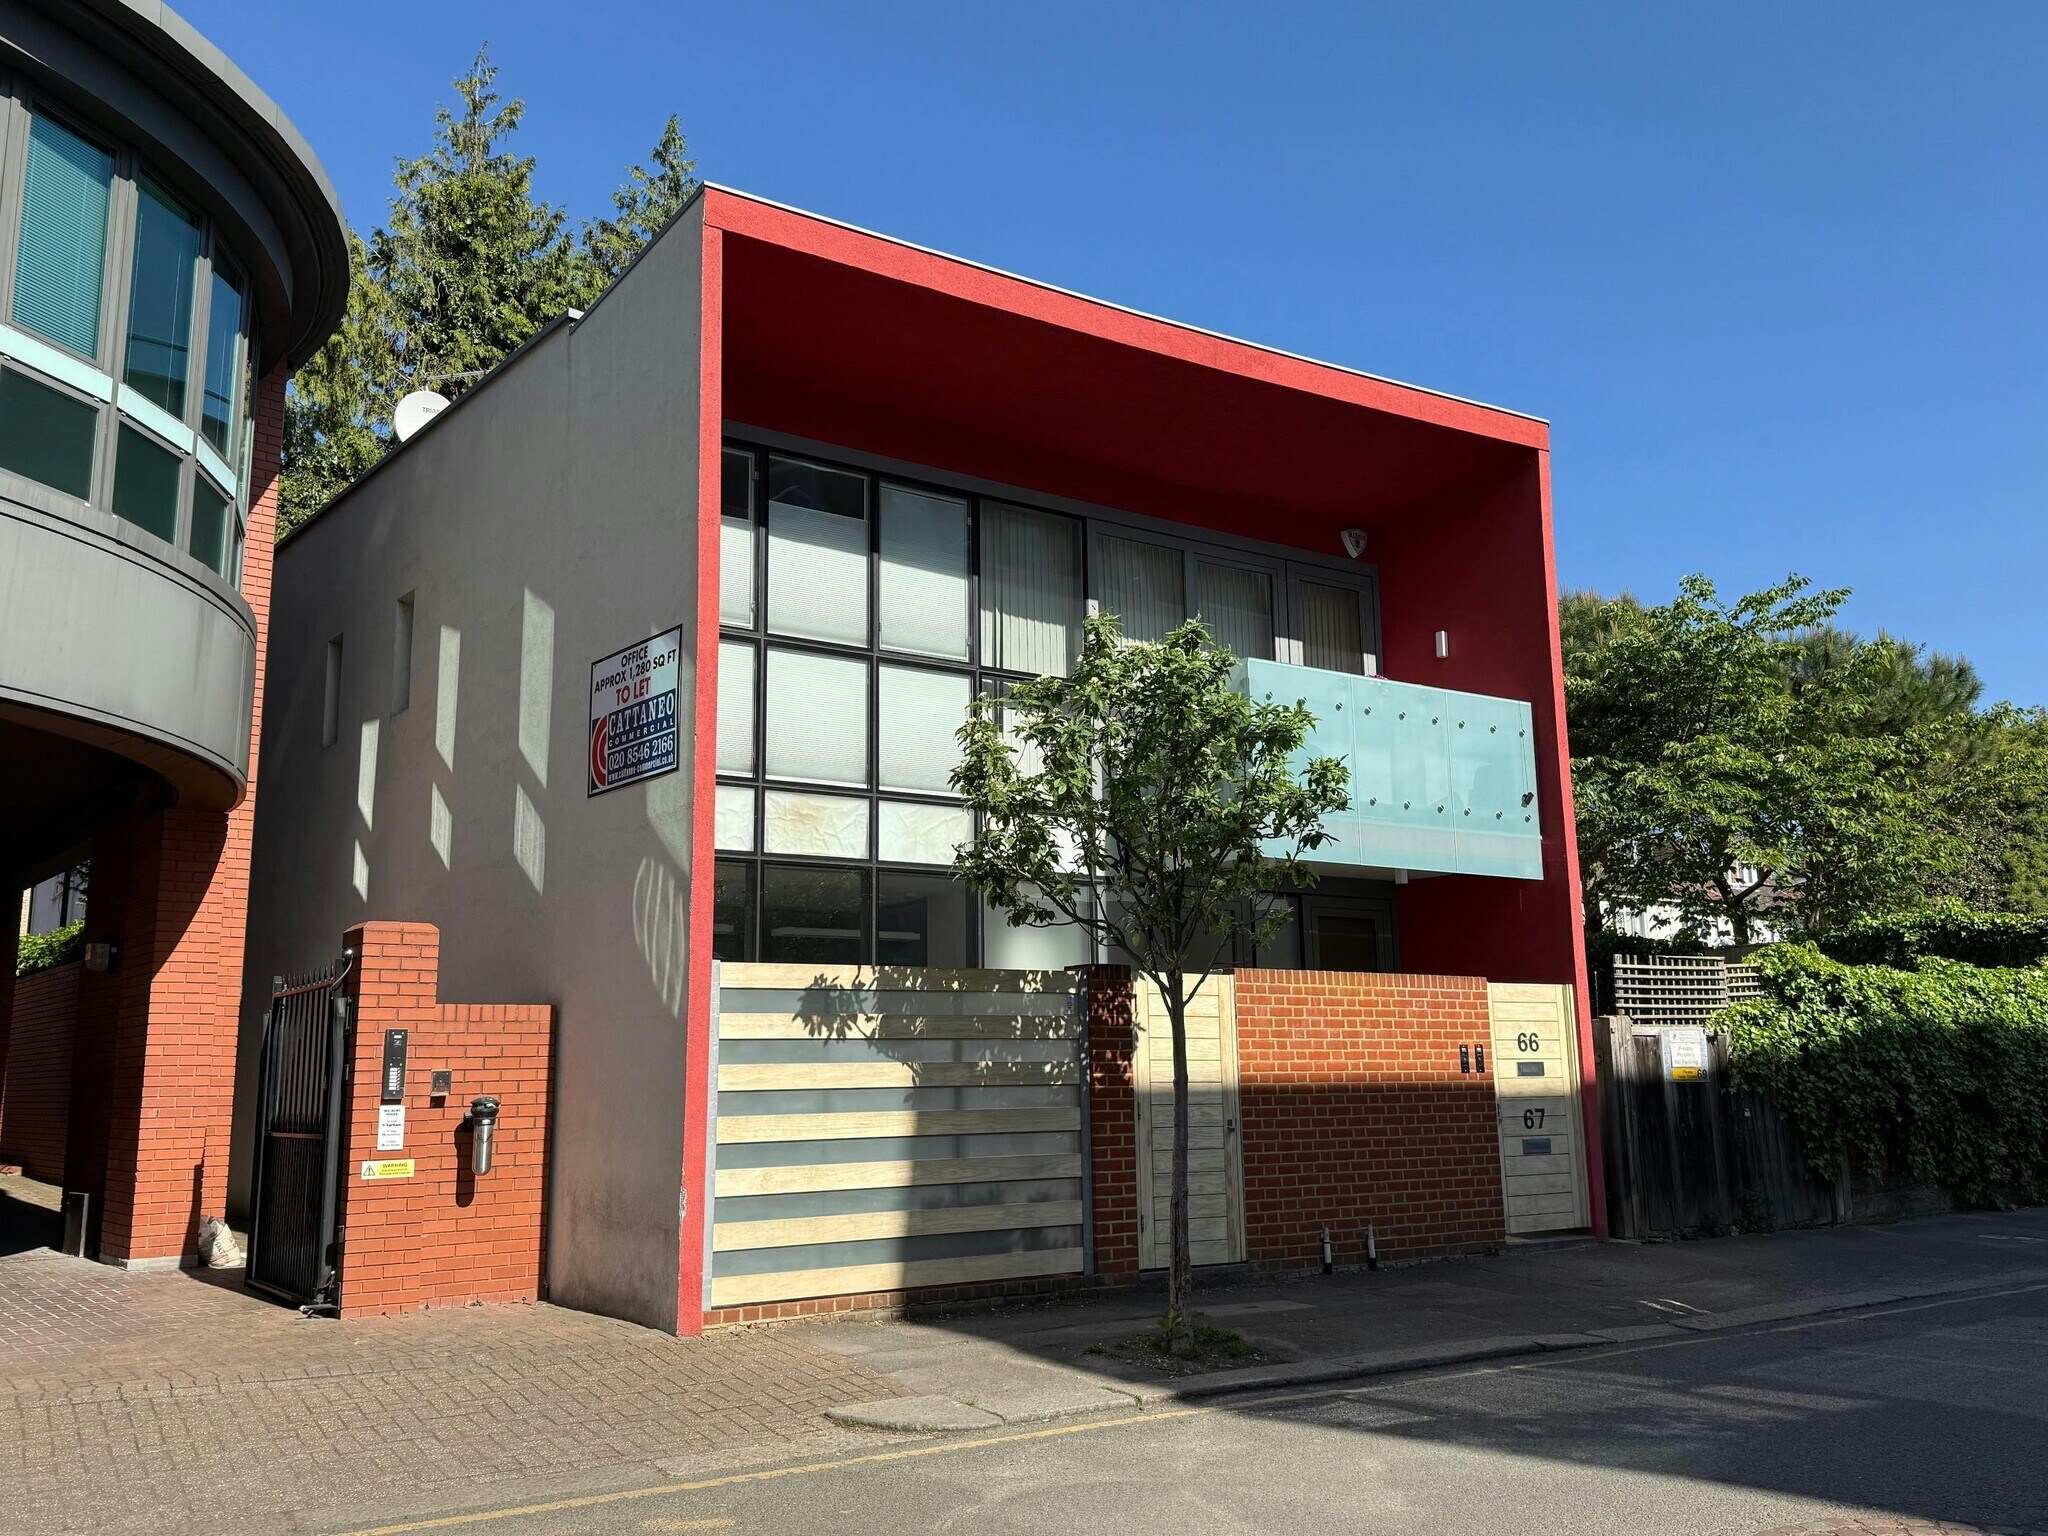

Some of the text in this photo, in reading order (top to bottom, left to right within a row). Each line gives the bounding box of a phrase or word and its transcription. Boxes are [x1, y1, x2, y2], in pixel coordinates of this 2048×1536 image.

[594, 648, 677, 694] APPROX 1,280 SQ FT
[621, 645, 649, 668] OFFICE
[615, 676, 651, 706] TO LET
[609, 692, 675, 736] CATTANEO
[608, 717, 674, 747] COMMERCIAL
[608, 734, 674, 771] 020 8546 2166
[1517, 1032, 1540, 1052] 66
[1696, 1068, 1708, 1080] 69
[1523, 1108, 1546, 1129] 67
